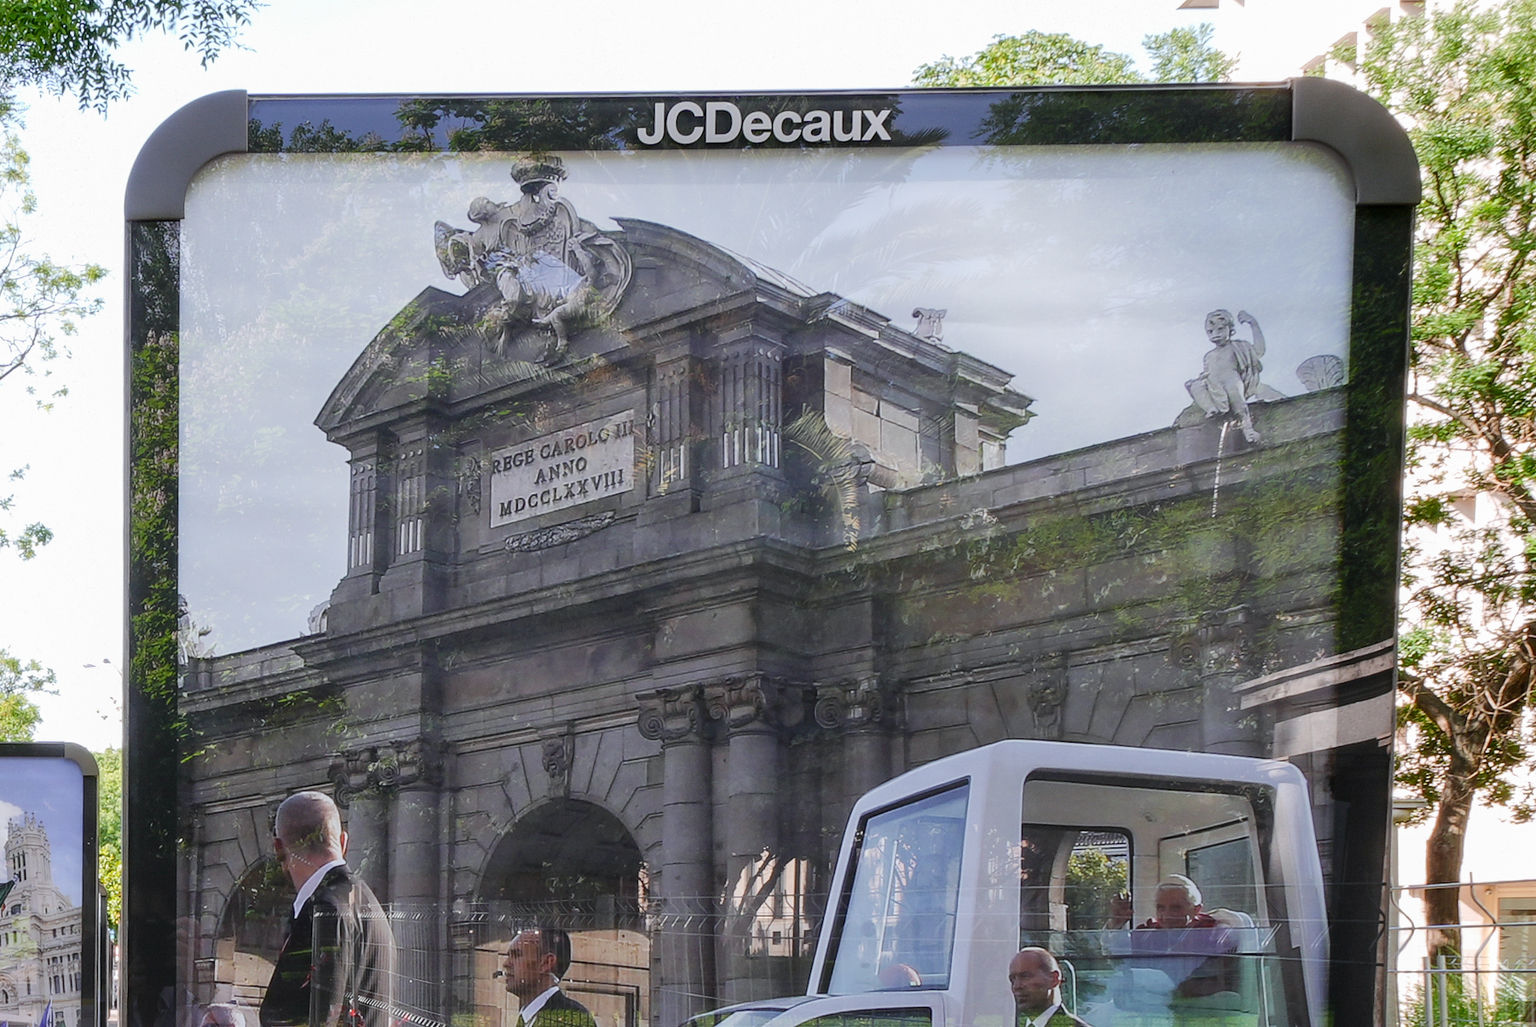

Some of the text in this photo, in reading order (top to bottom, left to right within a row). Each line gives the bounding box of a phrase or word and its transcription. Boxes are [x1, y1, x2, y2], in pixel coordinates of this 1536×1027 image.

[637, 101, 892, 144] JCDecaux
[492, 420, 634, 475] REGE CAROLO III
[499, 469, 625, 517] MDCCLXXVIII
[534, 457, 588, 485] ANNO
